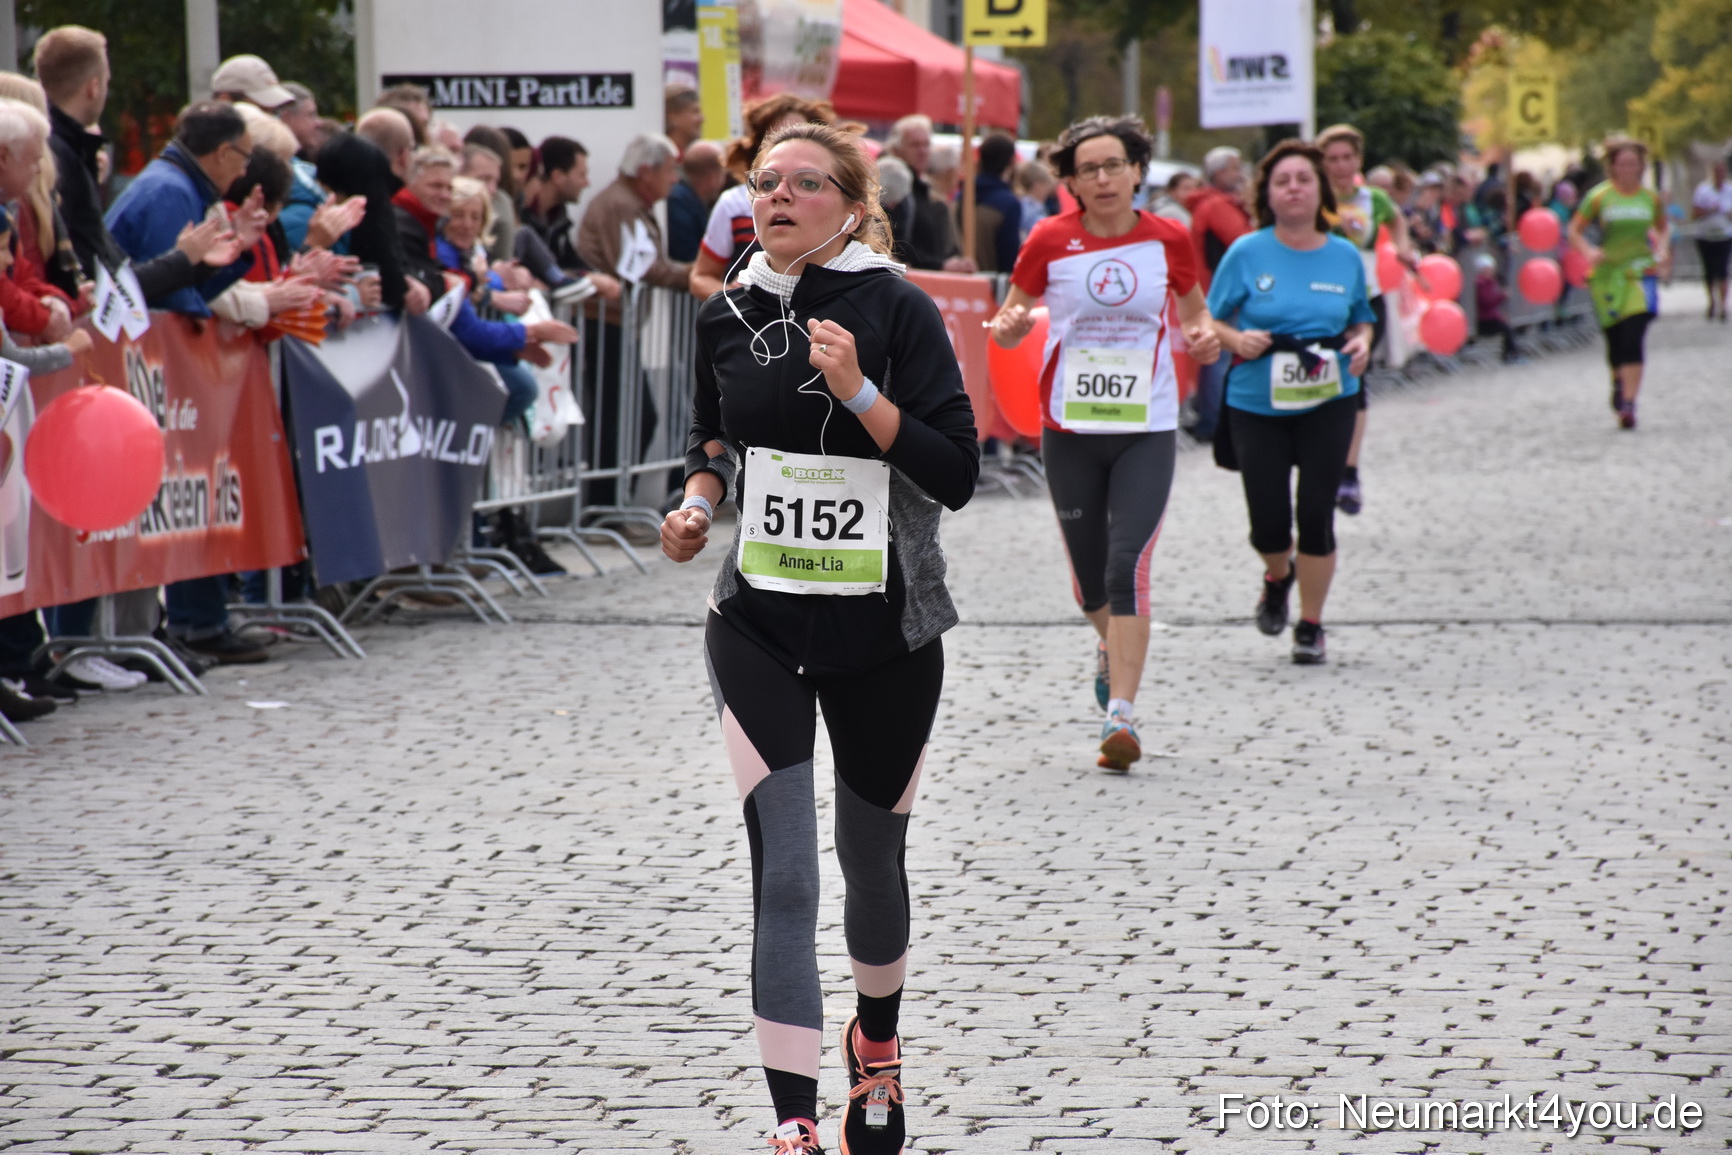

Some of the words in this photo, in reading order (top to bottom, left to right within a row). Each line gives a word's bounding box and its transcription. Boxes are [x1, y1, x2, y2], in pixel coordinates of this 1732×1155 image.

[424, 76, 626, 107] .MINI-Partl.de
[1519, 90, 1543, 125] C
[1076, 373, 1138, 399] 5067
[794, 467, 846, 481] BOCK
[749, 526, 755, 535] S
[763, 494, 864, 541] 5152
[779, 553, 844, 571] Anna-Lia
